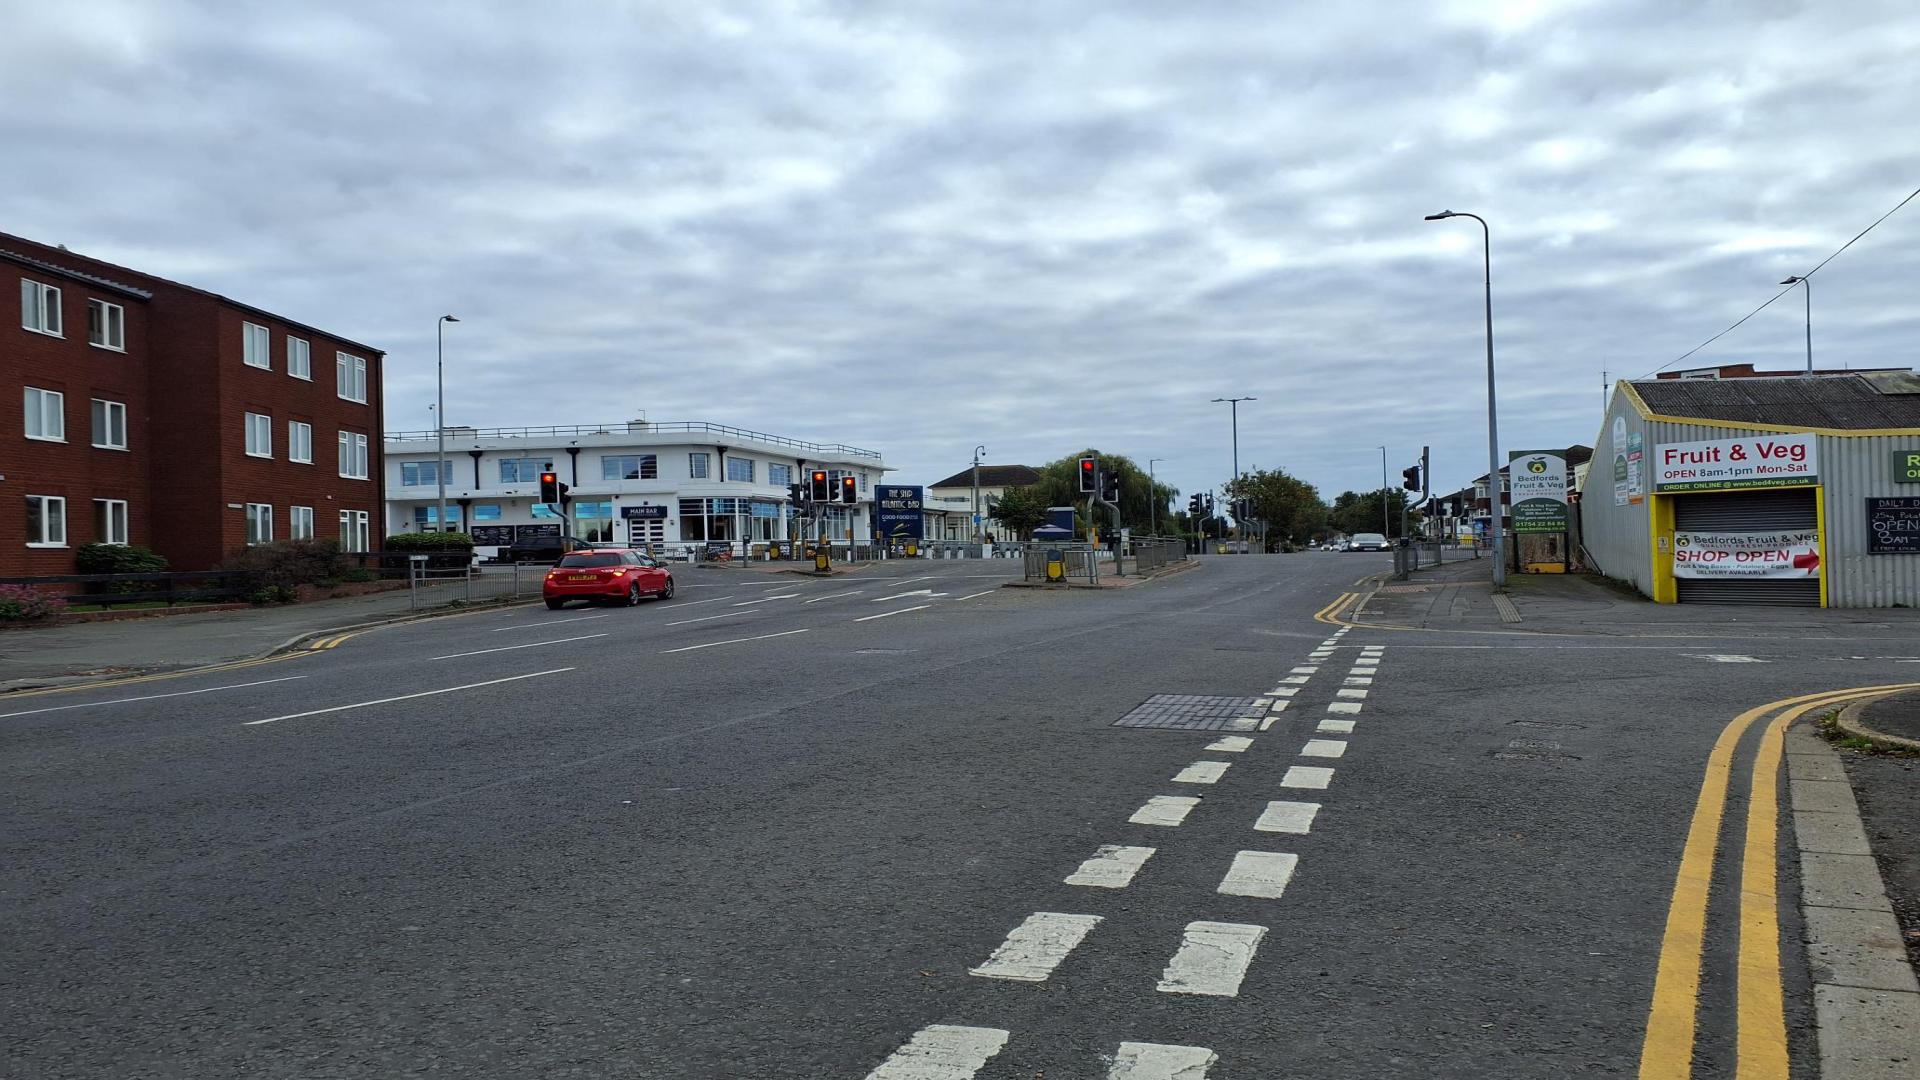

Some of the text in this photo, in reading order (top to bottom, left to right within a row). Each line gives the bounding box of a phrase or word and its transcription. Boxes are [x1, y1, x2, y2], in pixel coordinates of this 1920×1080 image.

[1664, 442, 1806, 466] Fruit & Veg
[1664, 464, 1808, 479] OPEN 8am-1pm Mon-Sat
[1732, 478, 1809, 488] www.bed4veg.co.uk
[1879, 500, 1904, 508] DAILY
[1873, 520, 1918, 531] OPEN
[1694, 536, 1744, 544] Bedfords
[1748, 535, 1777, 544] Fruit
[1794, 534, 1819, 543] Veg
[1676, 550, 1790, 562] SHOP OPEN
